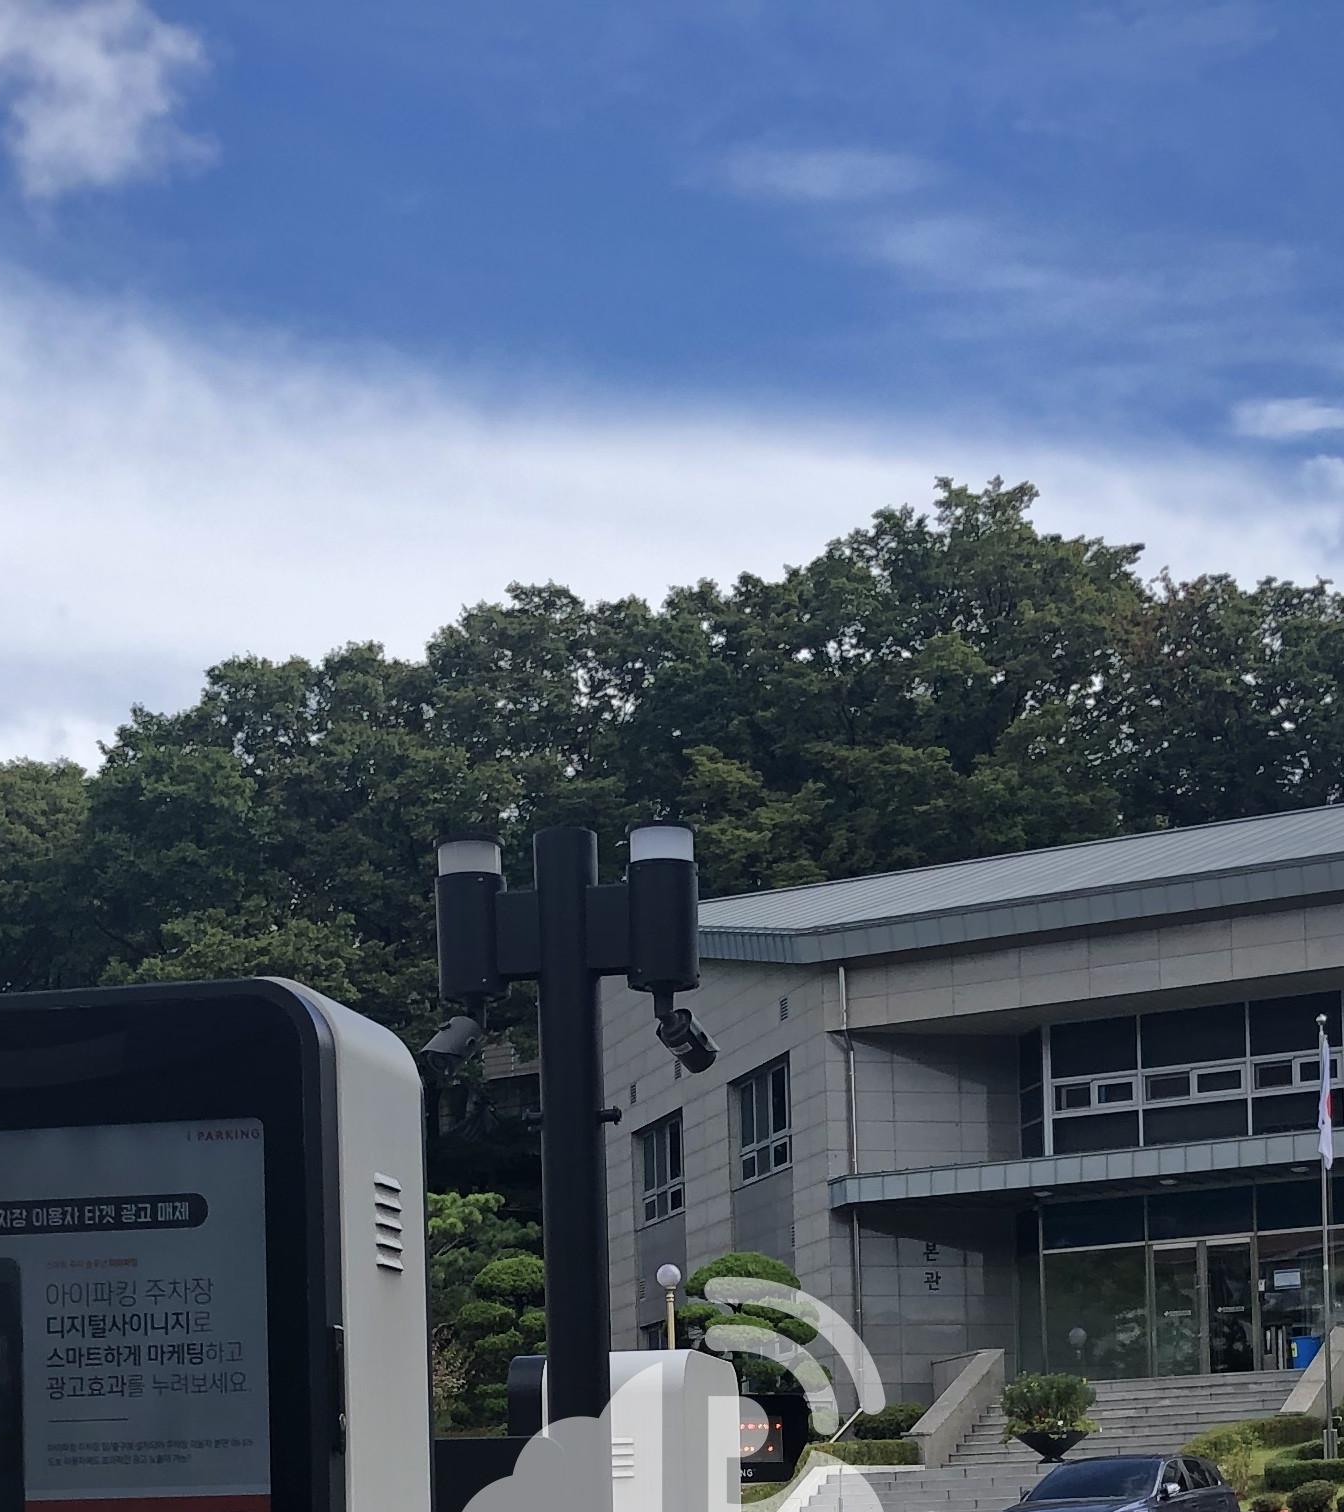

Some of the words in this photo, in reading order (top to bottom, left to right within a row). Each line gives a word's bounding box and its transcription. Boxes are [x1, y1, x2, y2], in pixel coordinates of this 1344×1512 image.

[197, 1129, 261, 1142] PARKING
[33, 1207, 79, 1227] 이용자
[85, 1206, 116, 1225] 타겟
[121, 1203, 151, 1223] 광고
[158, 1202, 190, 1221] 매체
[46, 1280, 137, 1308] 아이파킹
[145, 1278, 213, 1306] 주차장
[46, 1311, 213, 1339] 디지털사이니지로
[47, 1344, 141, 1368] 스마트하게
[148, 1341, 244, 1366] 마케팅하고
[46, 1374, 145, 1401] 광고효과를
